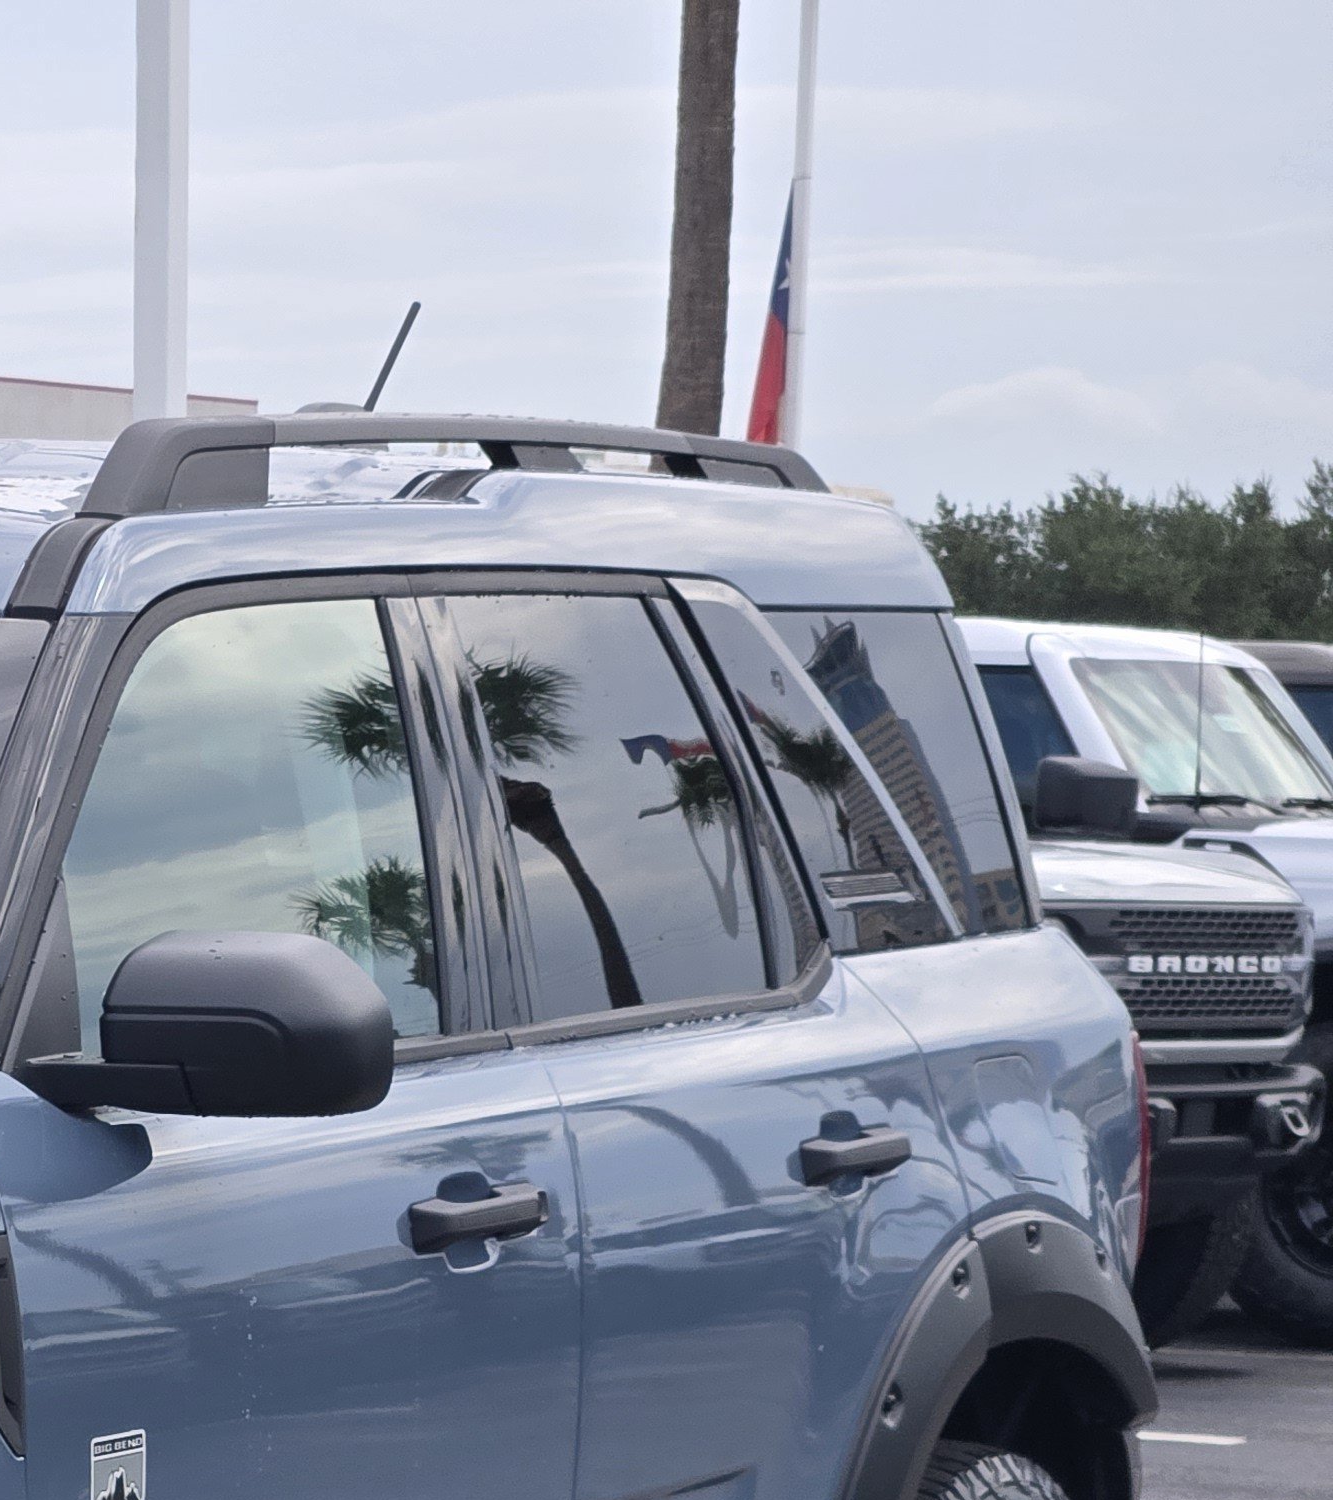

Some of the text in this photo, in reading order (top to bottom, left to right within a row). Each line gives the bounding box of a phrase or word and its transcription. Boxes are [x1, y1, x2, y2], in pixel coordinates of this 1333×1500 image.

[1128, 955, 1282, 973] BRONCO
[94, 1437, 143, 1455] BIG BEND
